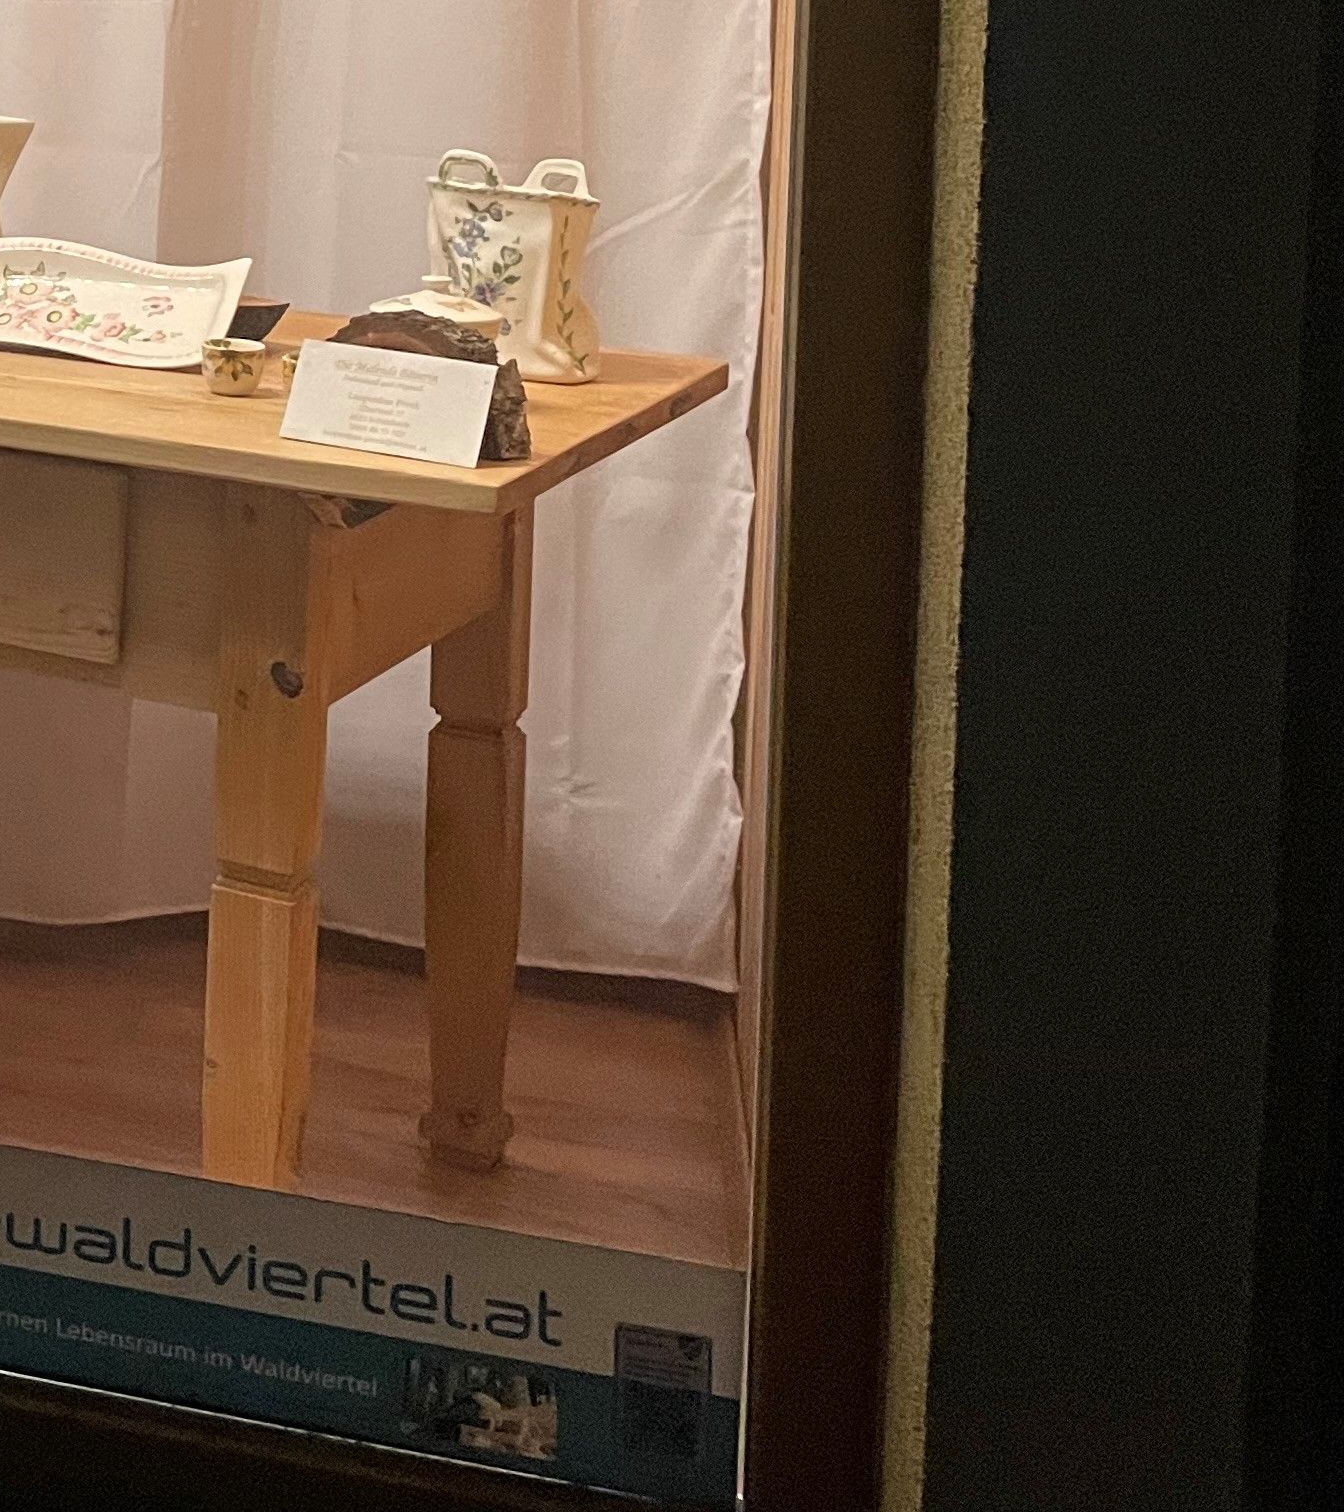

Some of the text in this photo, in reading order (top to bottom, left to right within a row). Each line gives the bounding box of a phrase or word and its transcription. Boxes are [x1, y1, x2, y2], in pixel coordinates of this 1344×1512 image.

[55, 1317, 198, 1363] Lebensraum
[202, 1347, 234, 1370] im
[240, 1353, 379, 1398] Waldviertel
